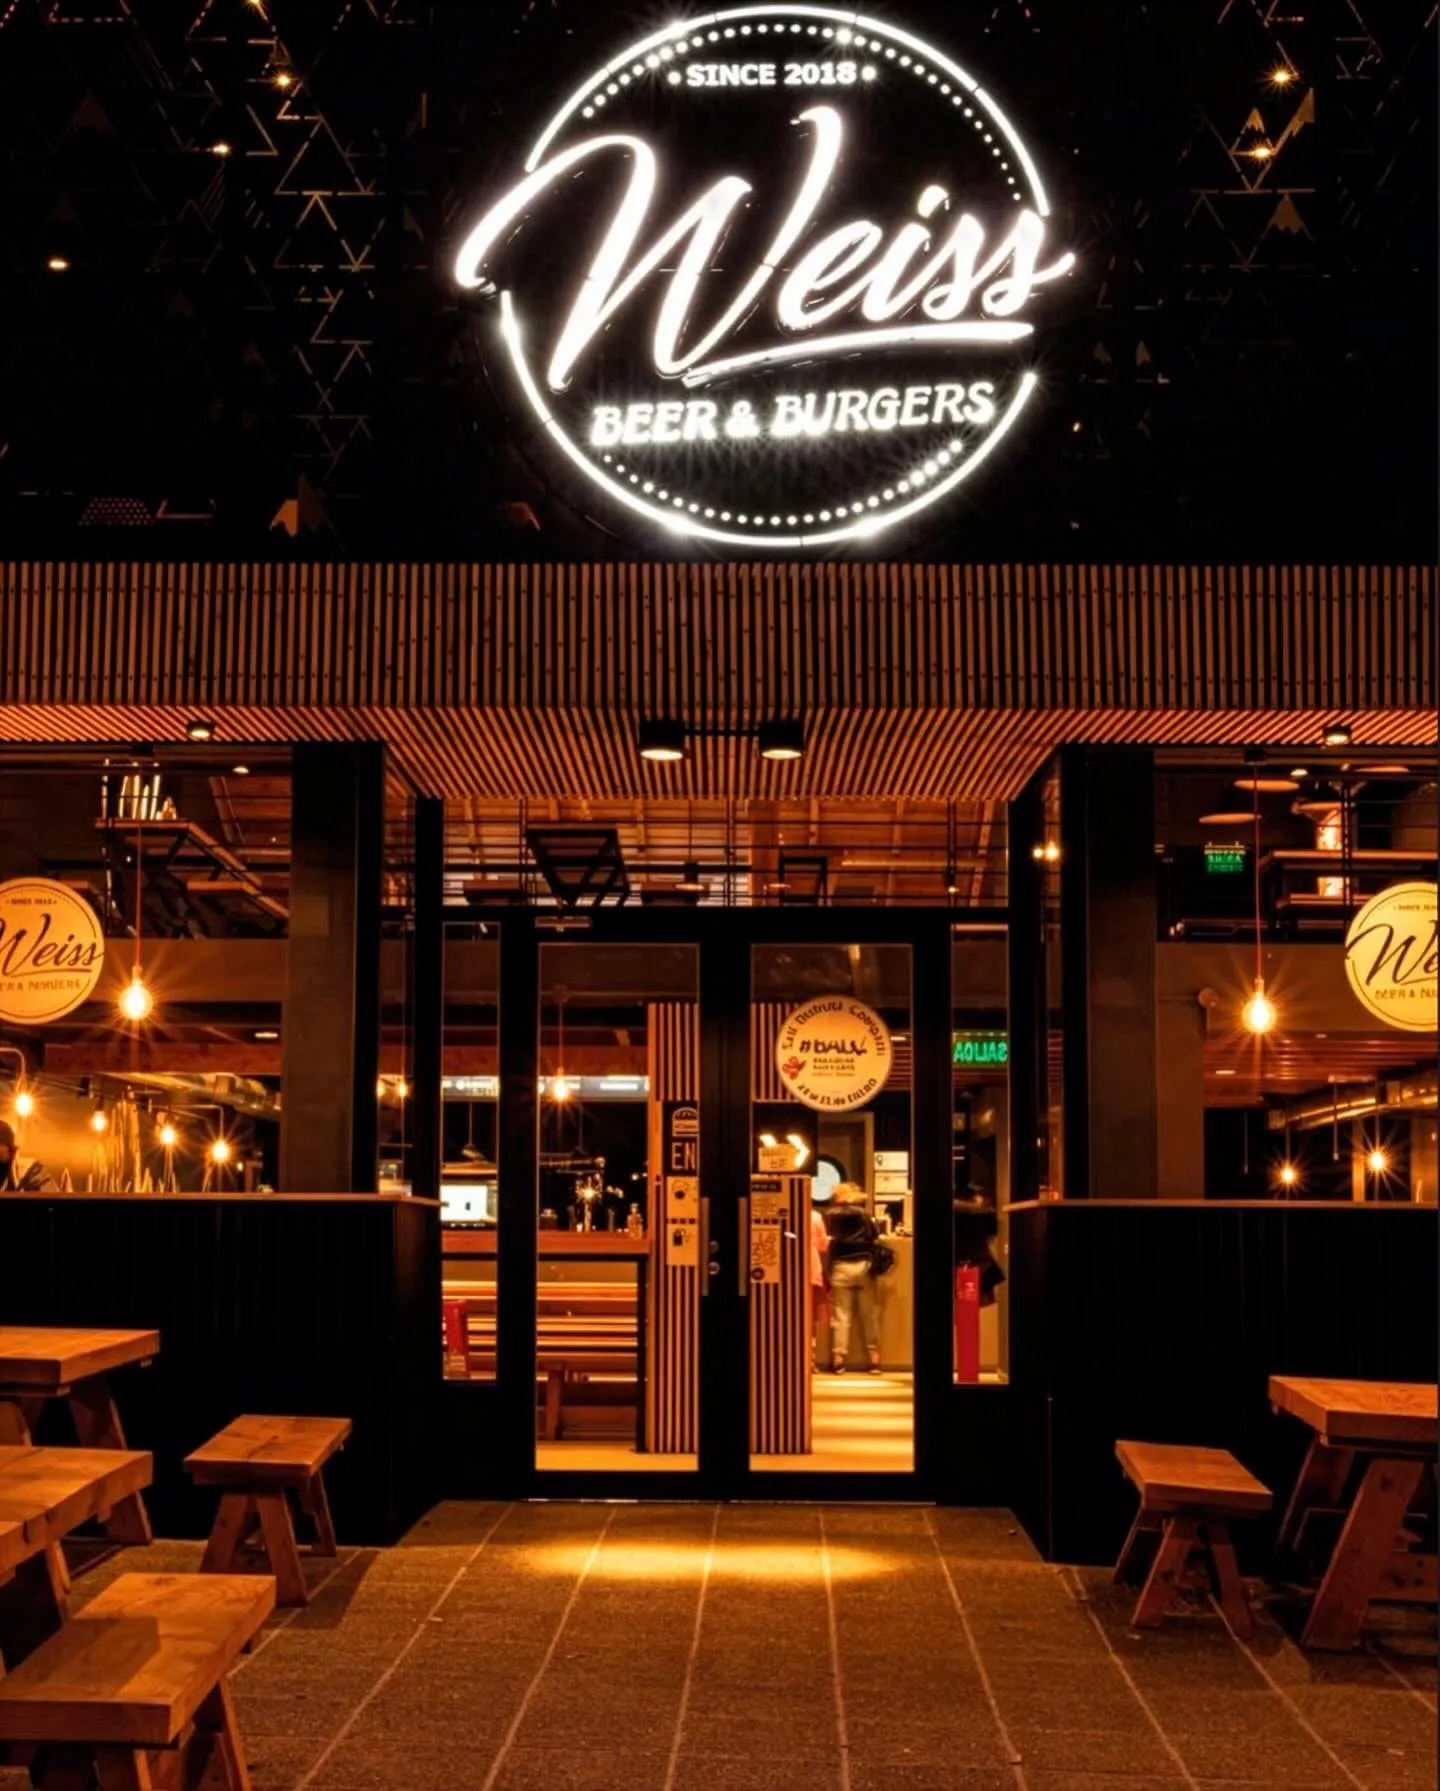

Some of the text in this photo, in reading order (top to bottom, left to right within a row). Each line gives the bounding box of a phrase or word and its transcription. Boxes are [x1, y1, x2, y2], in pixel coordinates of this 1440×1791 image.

[686, 61, 857, 87] SINCE 2018
[455, 105, 1075, 391] Weiss
[590, 381, 996, 446] BEER & BURGERS
[0, 913, 104, 977] Weiss
